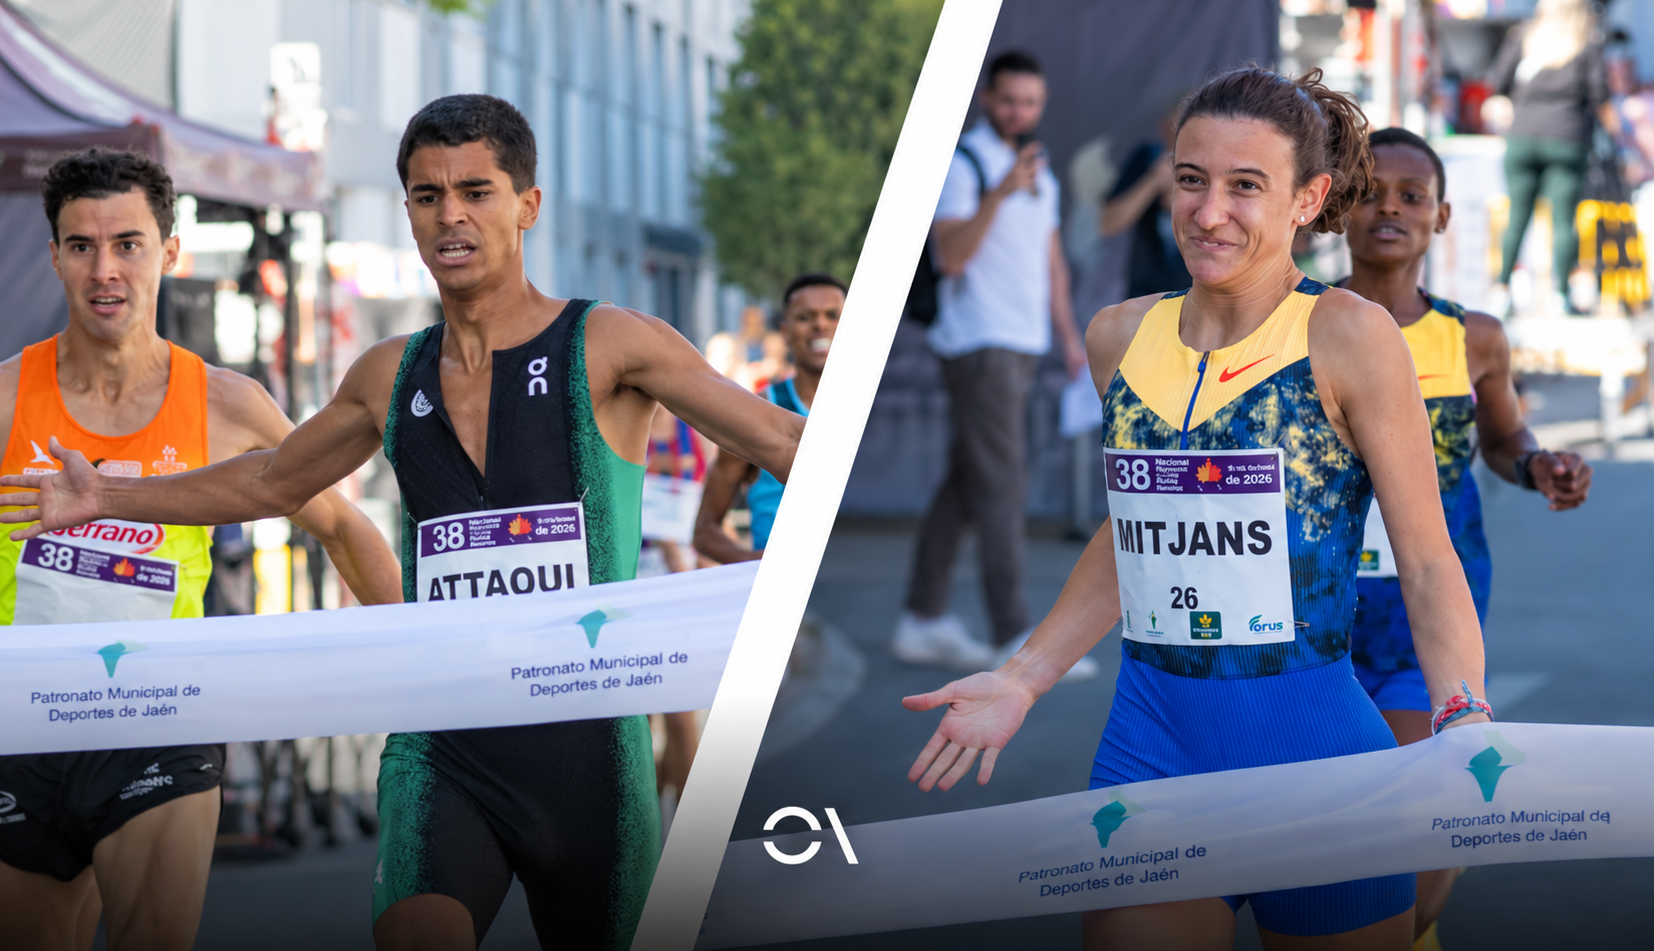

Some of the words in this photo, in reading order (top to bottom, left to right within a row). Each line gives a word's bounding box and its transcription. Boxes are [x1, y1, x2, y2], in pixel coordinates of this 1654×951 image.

[1116, 458, 1151, 490] 38
[1226, 474, 1240, 484] de
[1243, 473, 1273, 484] 2026
[432, 522, 465, 551] 38
[535, 526, 548, 535] de
[551, 523, 576, 534] 2026
[1117, 518, 1273, 556] MITJANS
[37, 543, 74, 571] 38
[428, 563, 575, 602] ATTAOUI
[1170, 586, 1199, 610] 26
[511, 662, 585, 680] Patronato
[590, 653, 663, 671] Municipal
[668, 652, 688, 664] de
[31, 689, 103, 704] Patronato
[108, 686, 178, 700] Municipal
[182, 685, 201, 697] de
[530, 679, 597, 697] Deportes
[602, 677, 621, 689] de
[626, 672, 662, 687] Jaén
[49, 707, 115, 723] Deportes
[119, 705, 137, 718] de
[141, 704, 177, 717] Jaén
[1431, 812, 1506, 831] Patronato
[1511, 810, 1584, 825] Municipal
[1451, 831, 1521, 849] Deportes
[1525, 829, 1545, 842] de
[1549, 828, 1587, 842] Jaén
[1018, 860, 1095, 883] Patronato
[1100, 847, 1179, 869] Municipal
[1185, 845, 1207, 858] de
[1040, 877, 1110, 897] Deportes
[1114, 873, 1134, 886] de
[1140, 868, 1179, 883] Jaén
